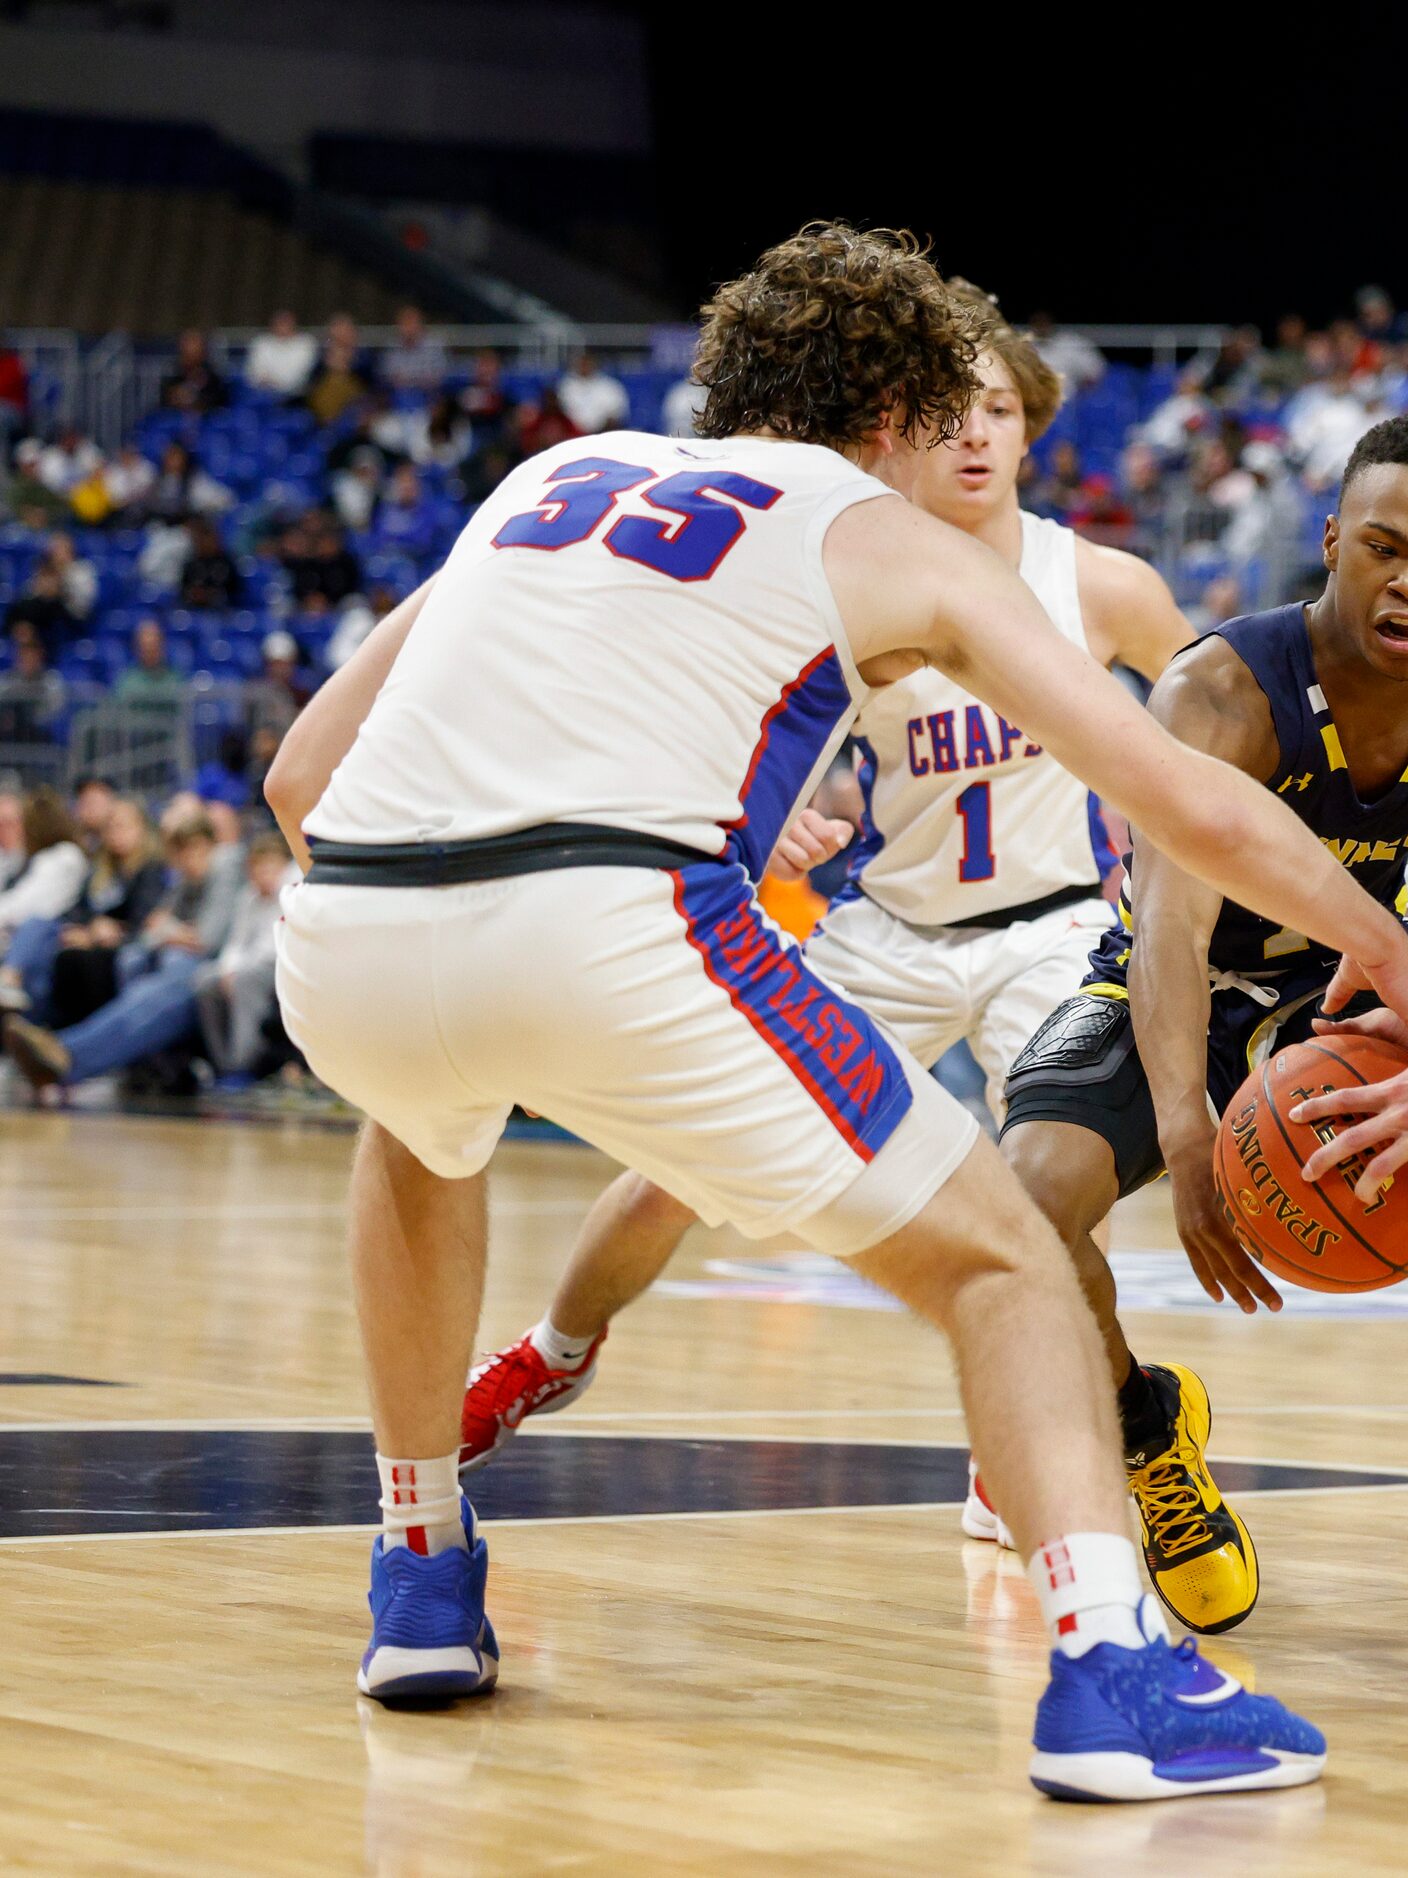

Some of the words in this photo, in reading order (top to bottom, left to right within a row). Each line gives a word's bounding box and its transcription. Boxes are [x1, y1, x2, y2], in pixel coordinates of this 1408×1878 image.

[492, 456, 784, 582] 35
[907, 705, 1043, 777] CHAP
[956, 780, 996, 883] 1
[1231, 1098, 1342, 1257] SPALDING
